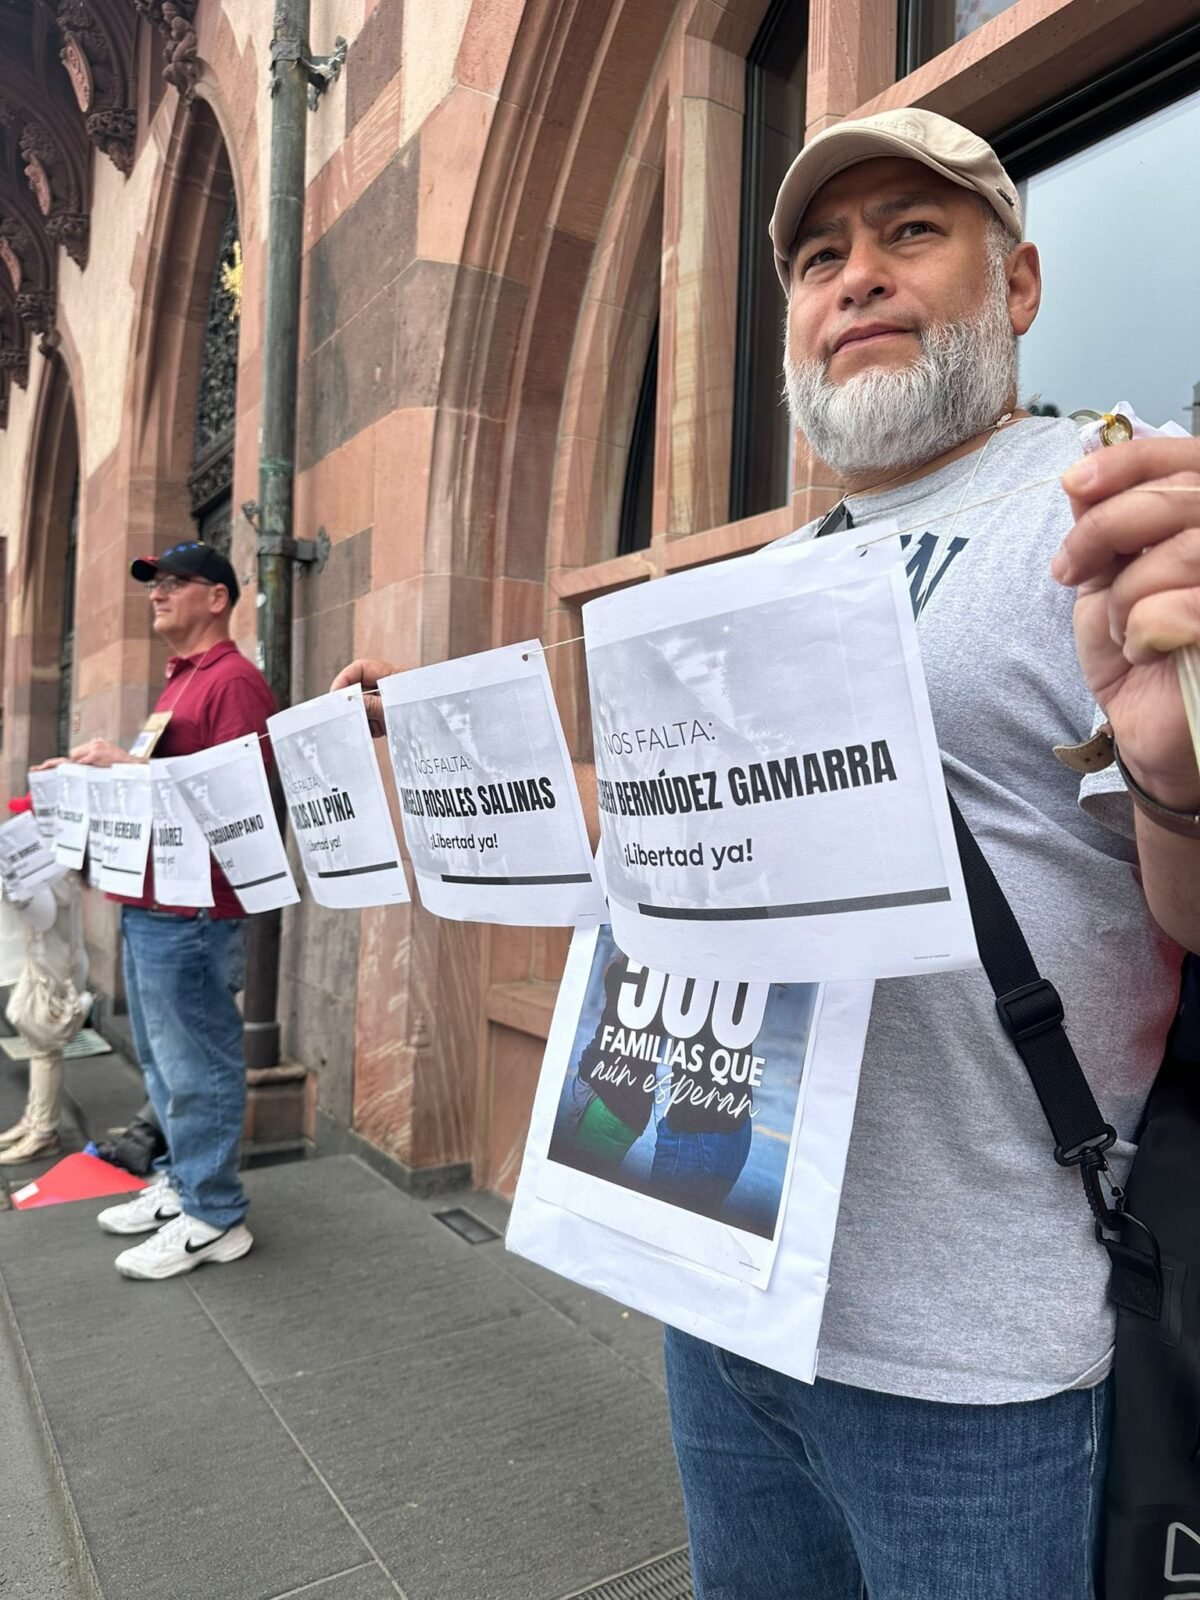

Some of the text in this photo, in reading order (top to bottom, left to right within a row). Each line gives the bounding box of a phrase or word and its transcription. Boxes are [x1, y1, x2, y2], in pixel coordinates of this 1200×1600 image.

[604, 719, 716, 755] NOS FALTA:
[414, 755, 473, 775] NOS FALTA:
[615, 768, 724, 817] BERMÚDEZ
[727, 739, 898, 807] GAMARRA
[322, 787, 355, 825] PIÑA
[423, 786, 478, 818] ROSALES
[477, 776, 556, 815] SALINAS
[431, 833, 499, 853] ¡Libertad ya!
[624, 838, 753, 871] ¡Libertad ya!
[600, 1025, 767, 1088] FAMILIAS QUE
[643, 1072, 761, 1119] esperan
